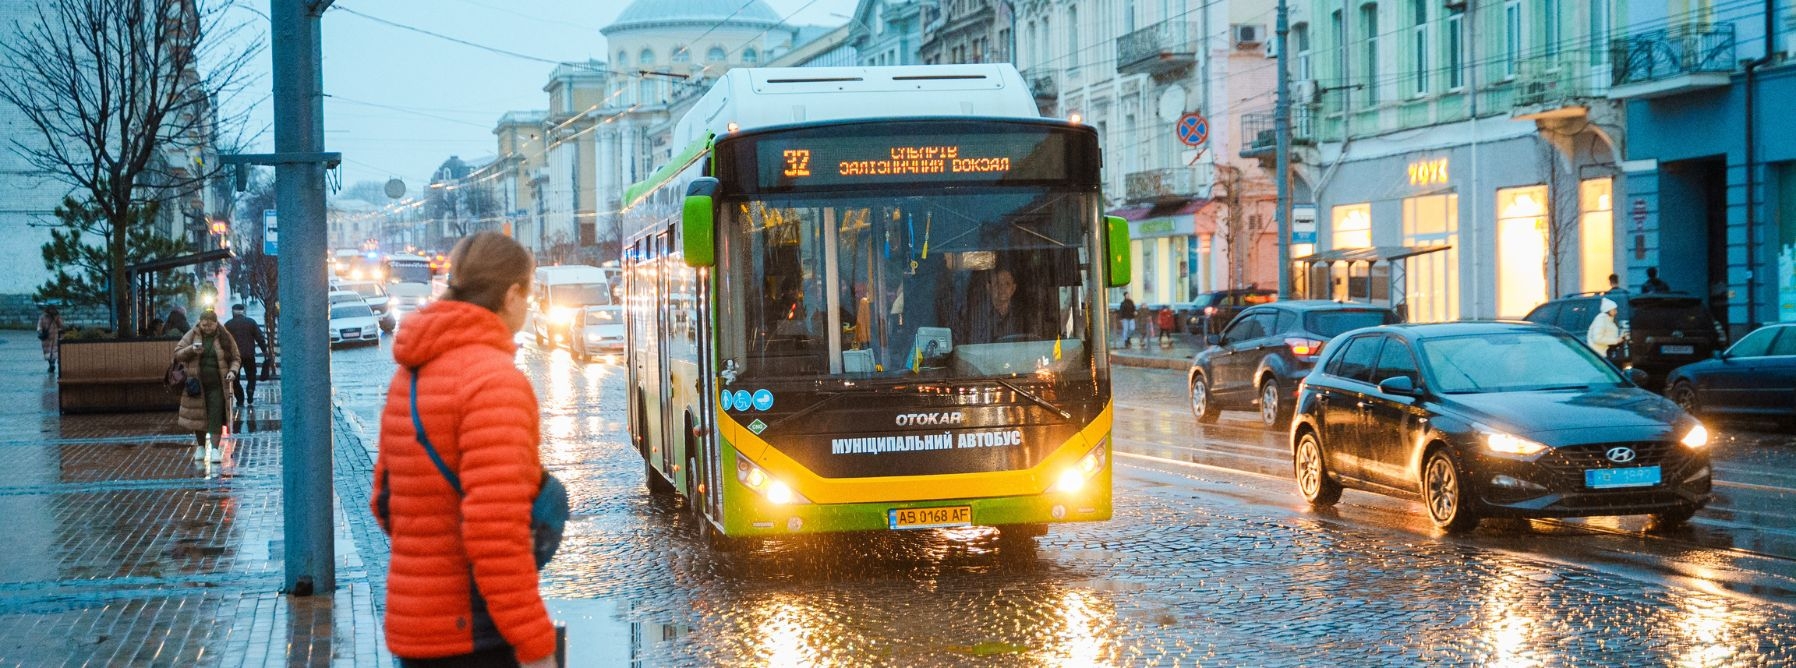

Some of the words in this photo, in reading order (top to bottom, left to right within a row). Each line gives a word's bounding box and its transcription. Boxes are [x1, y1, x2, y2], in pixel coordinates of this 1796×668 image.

[783, 149, 810, 176] 32
[895, 411, 962, 426] OTOKAR
[831, 431, 953, 455] МУНІЦИПАЛЬНИЙ
[957, 430, 1021, 449] АВТОБУС
[899, 511, 916, 524] AB
[919, 509, 948, 523] 0168
